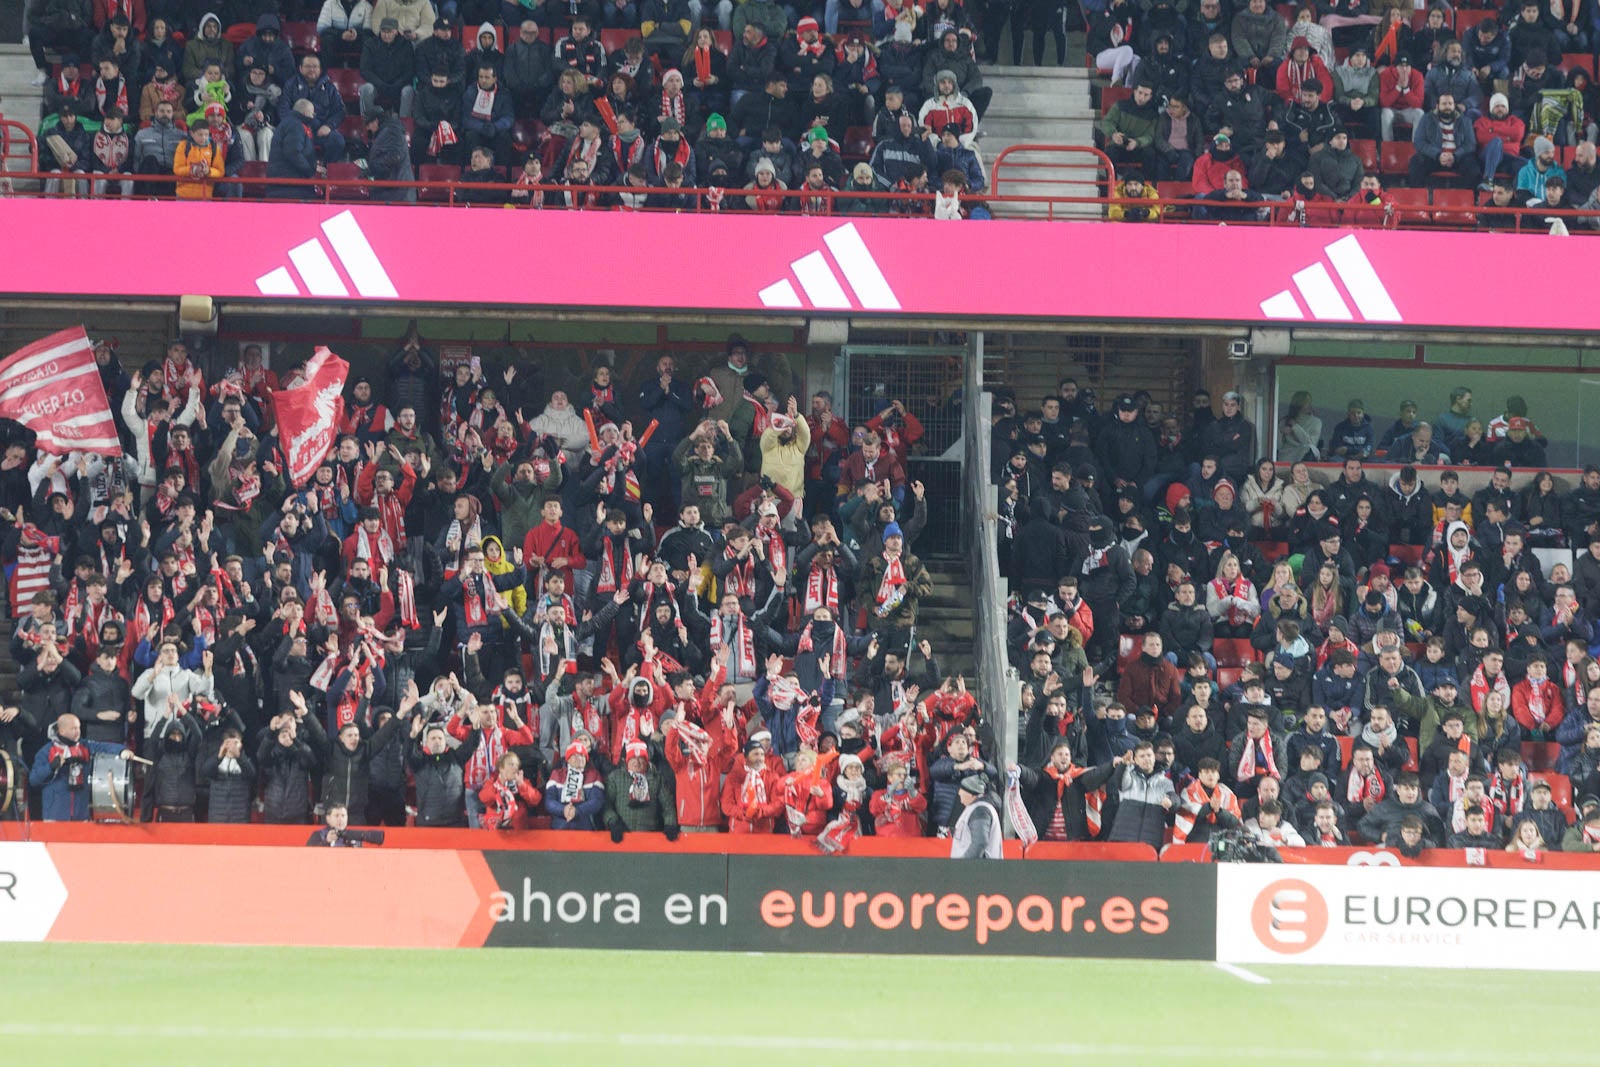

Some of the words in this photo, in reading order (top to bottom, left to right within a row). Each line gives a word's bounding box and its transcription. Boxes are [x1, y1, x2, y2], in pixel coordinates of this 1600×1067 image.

[488, 877, 640, 924] ahora
[664, 892, 727, 926] en
[760, 889, 1170, 945] eurorepar.es
[1344, 932, 1379, 944] CAR
[1387, 932, 1464, 945] SERVICE
